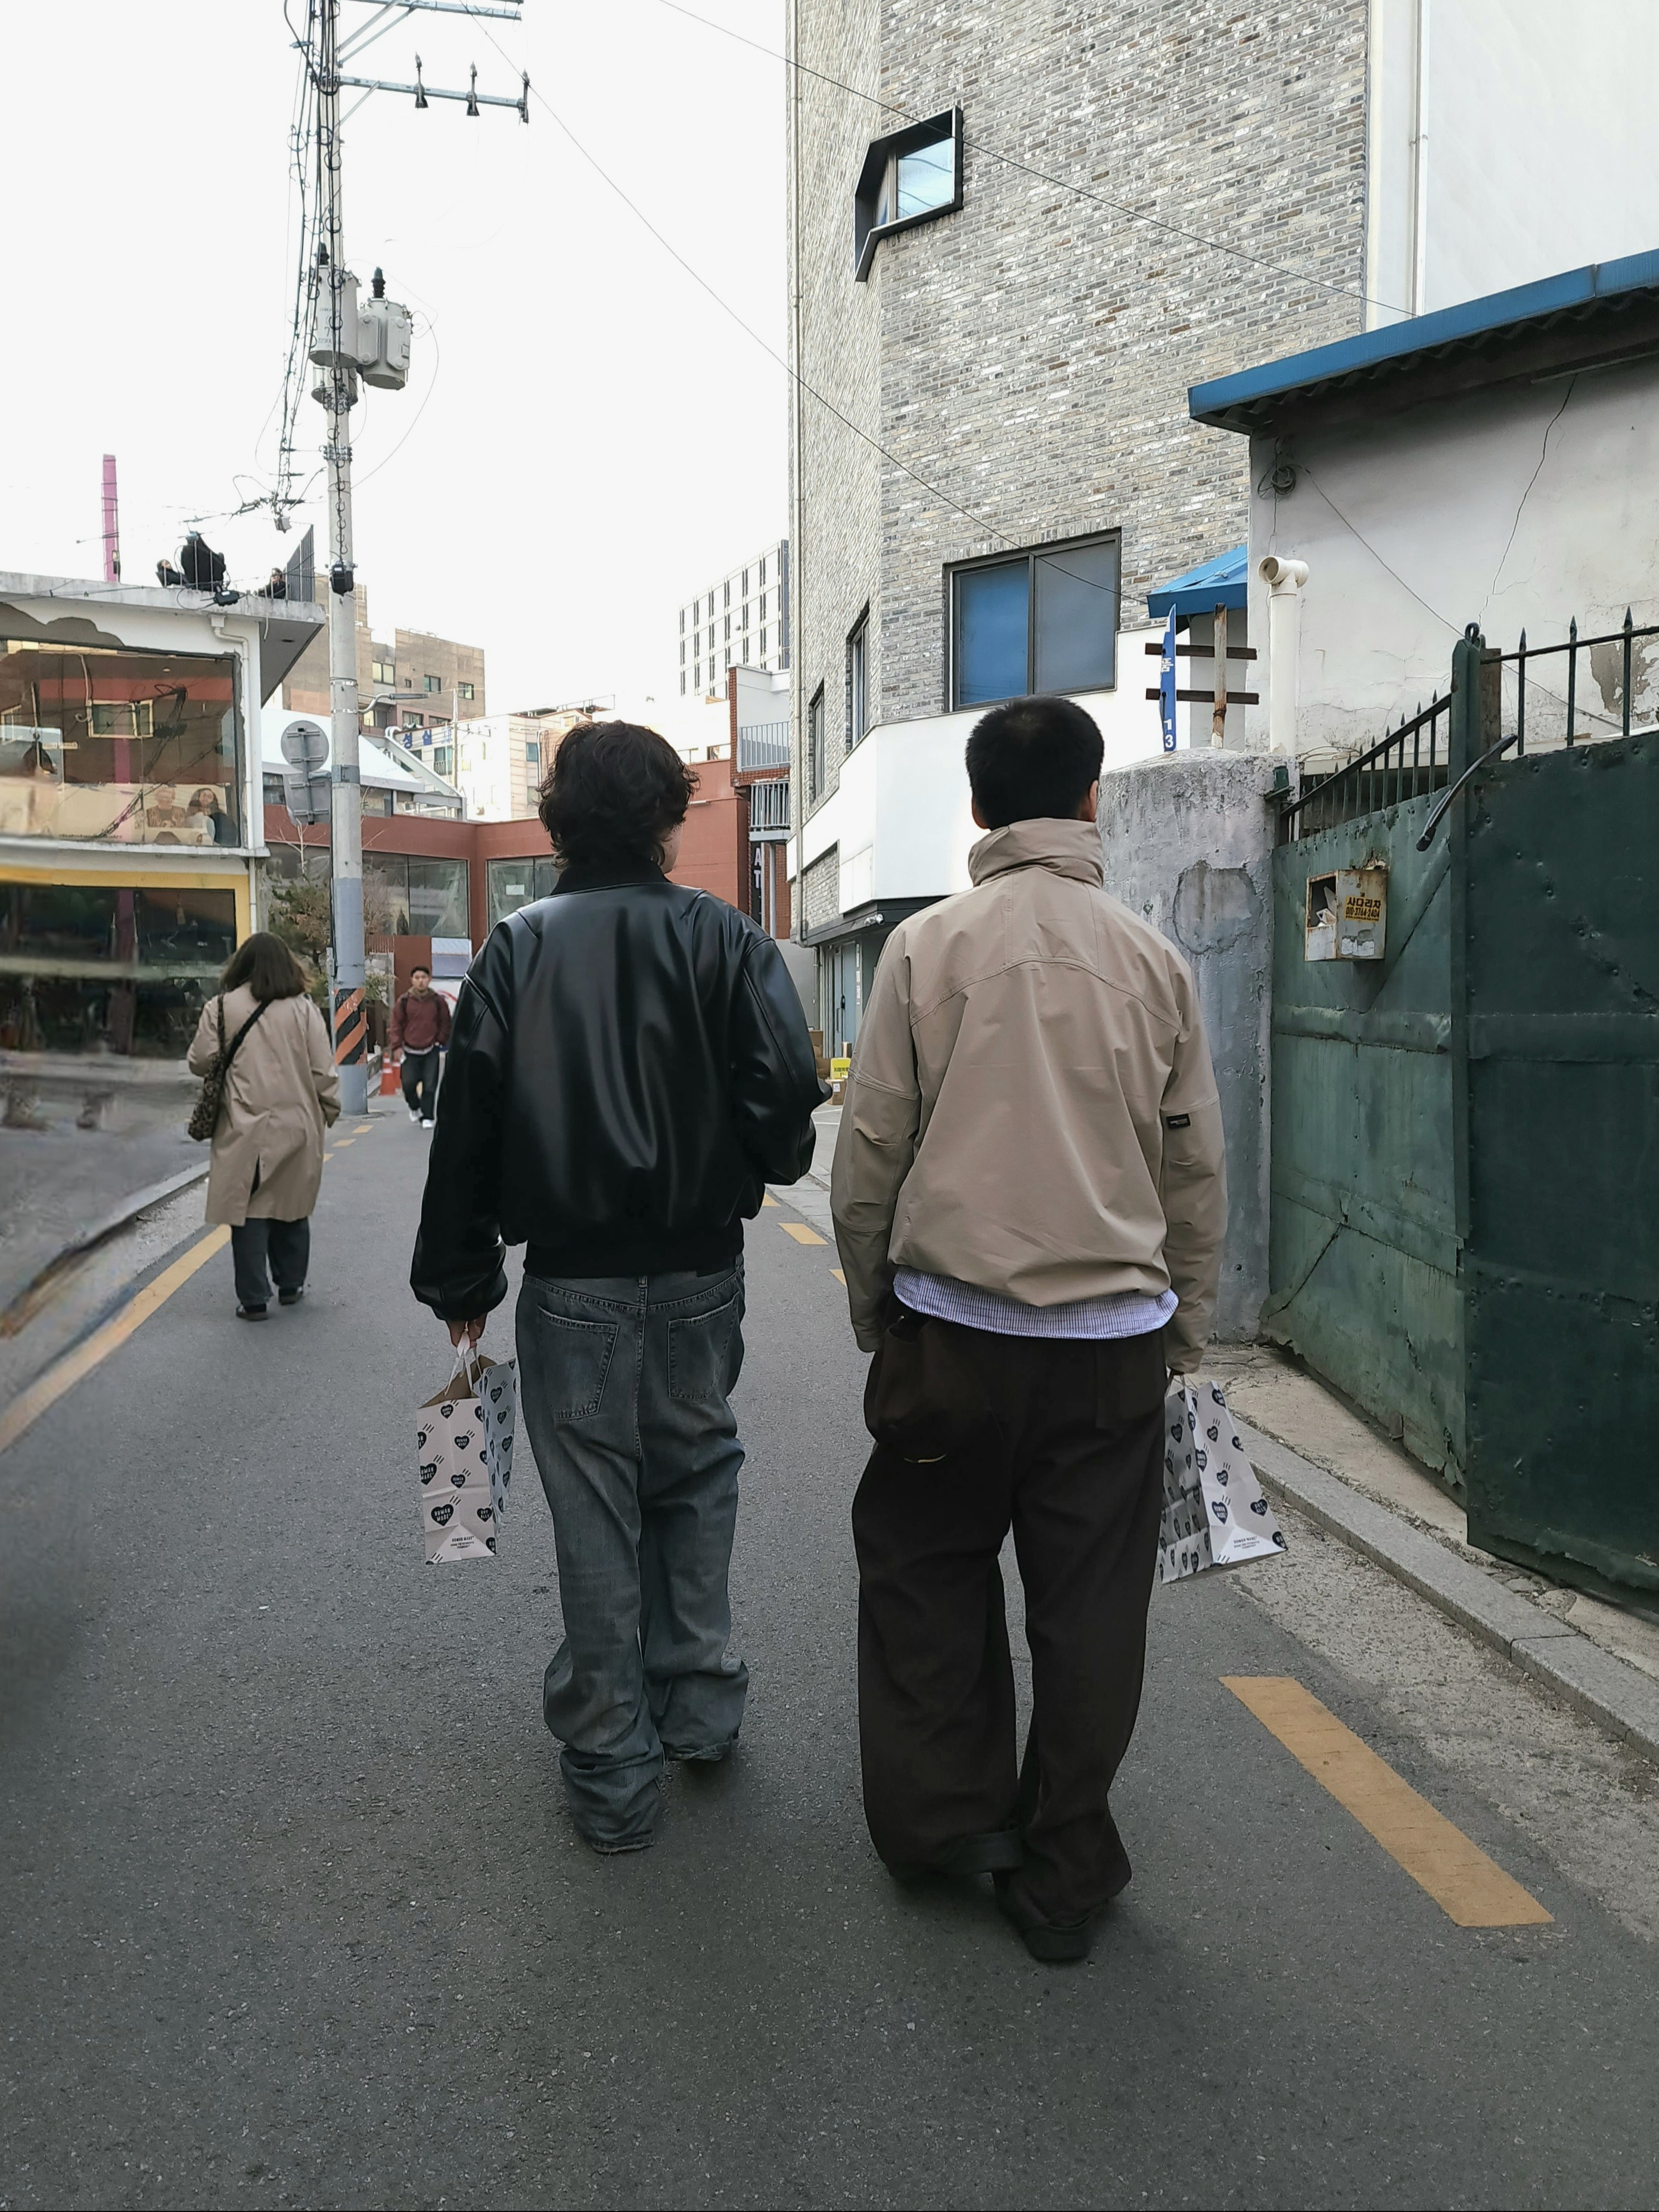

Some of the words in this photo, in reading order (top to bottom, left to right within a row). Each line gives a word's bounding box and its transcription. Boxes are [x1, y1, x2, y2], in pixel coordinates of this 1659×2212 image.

[1347, 897, 1381, 909] 사다리차
[1346, 906, 1380, 918] 010-3764-2404
[434, 1508, 451, 1516] HUMAN
